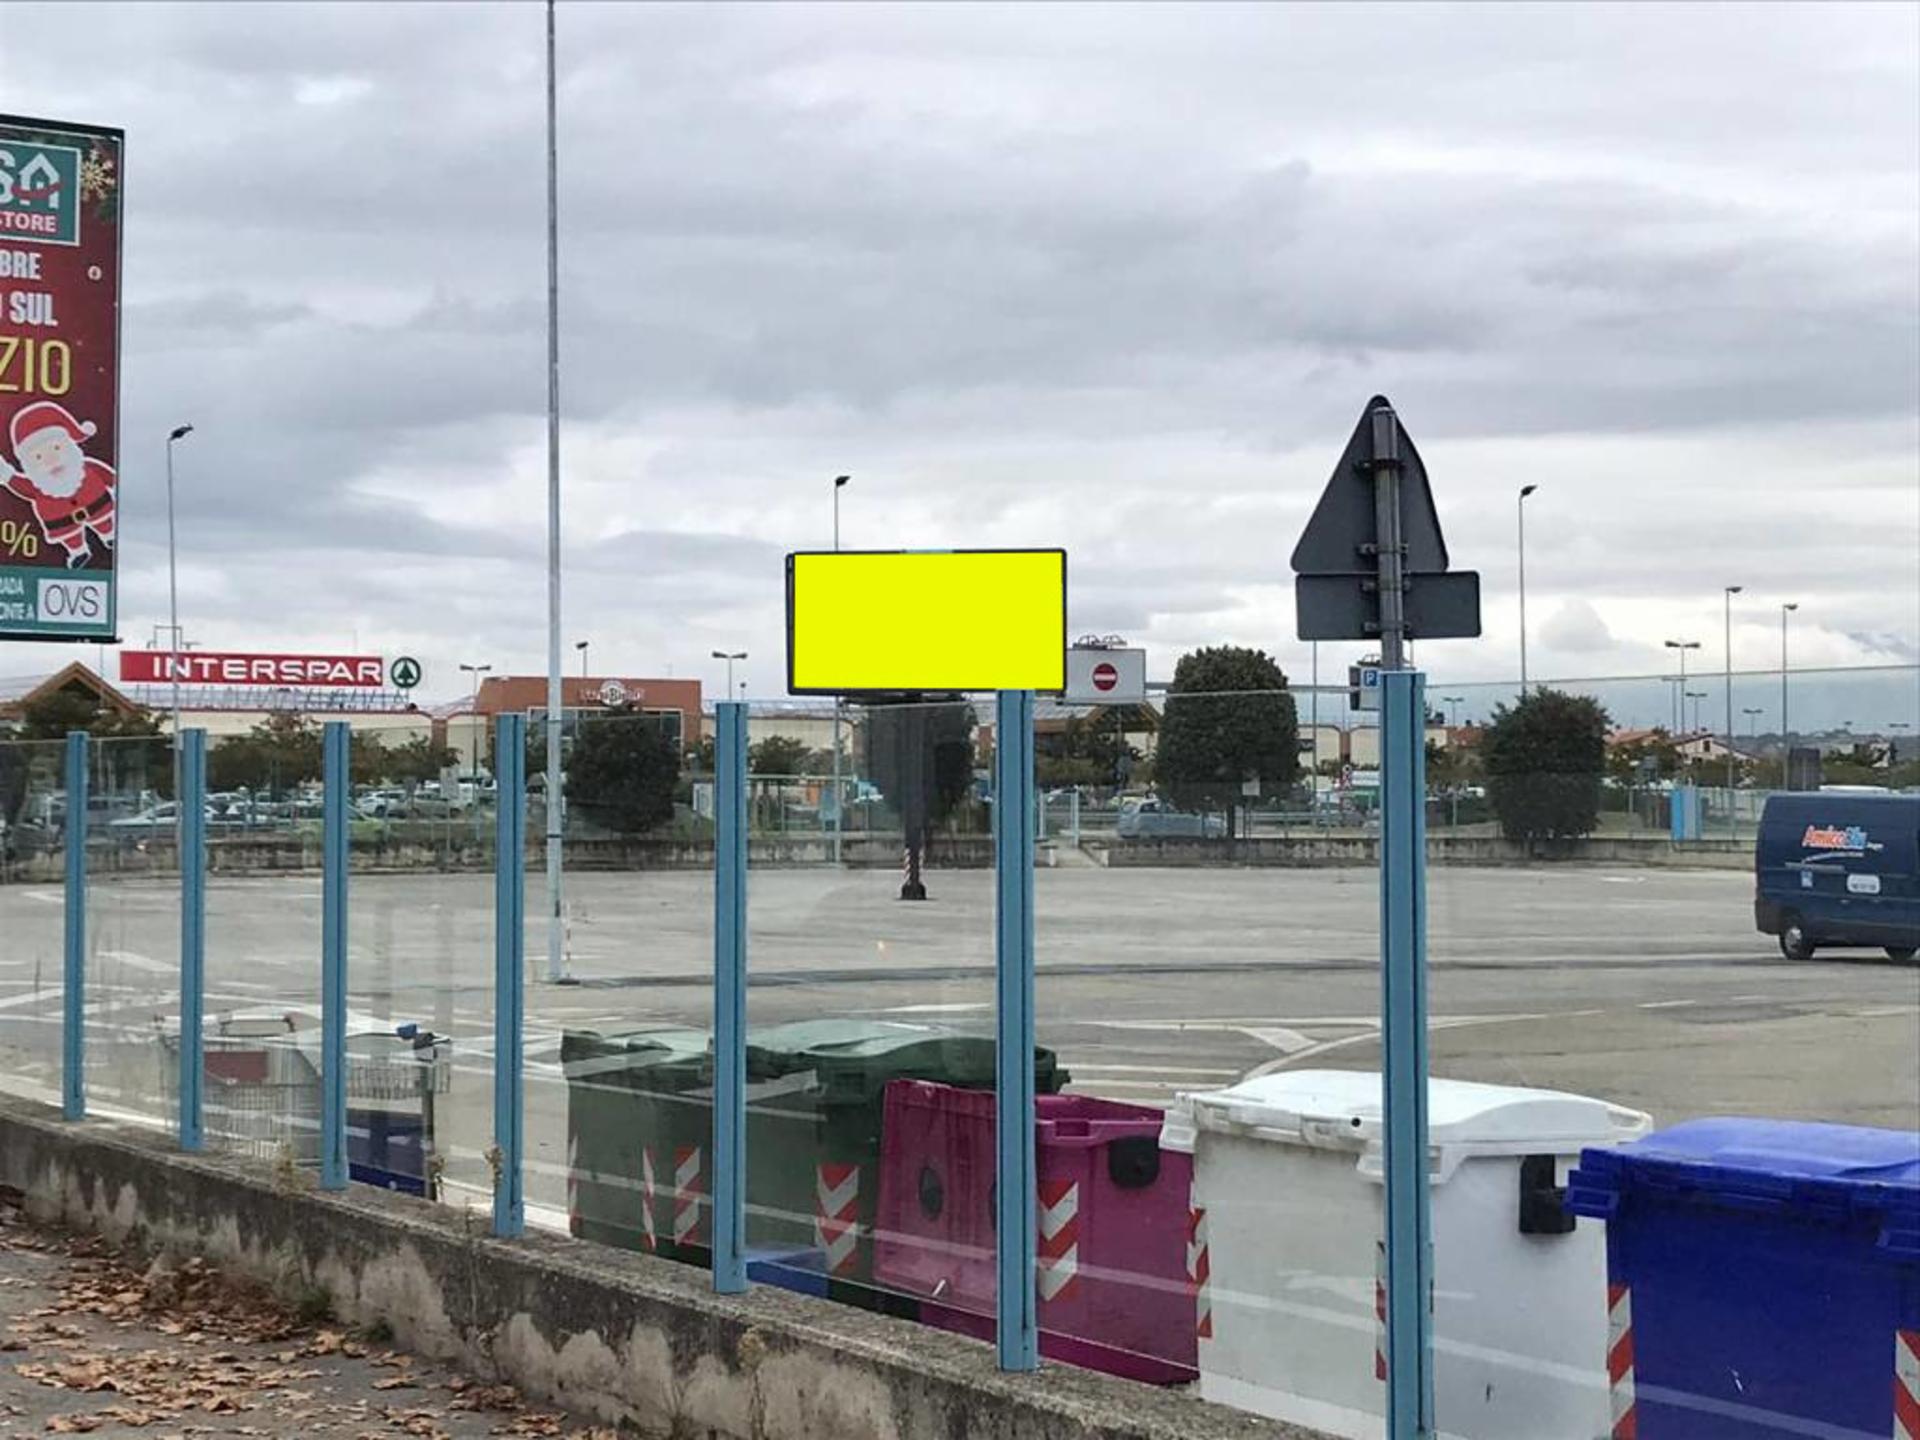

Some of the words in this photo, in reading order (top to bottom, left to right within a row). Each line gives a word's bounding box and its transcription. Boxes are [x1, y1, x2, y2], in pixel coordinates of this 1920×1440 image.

[0, 211, 57, 233] TORE
[9, 290, 59, 327] SUL
[0, 336, 71, 395] ZIO
[44, 584, 99, 618] OVS
[153, 656, 382, 682] INTERSPAR
